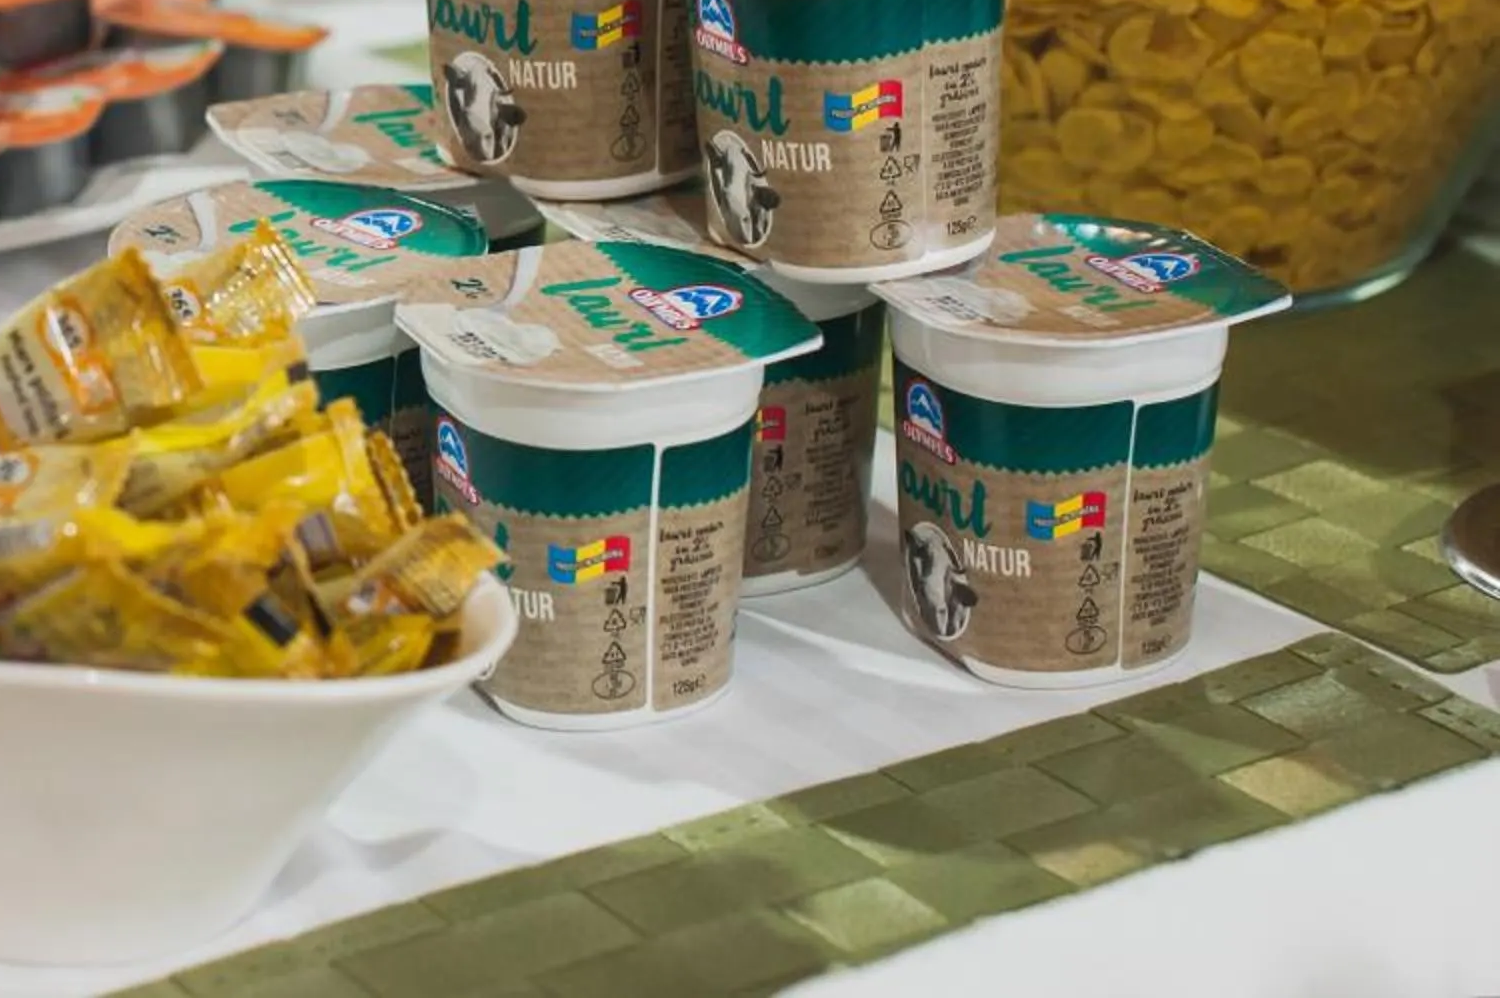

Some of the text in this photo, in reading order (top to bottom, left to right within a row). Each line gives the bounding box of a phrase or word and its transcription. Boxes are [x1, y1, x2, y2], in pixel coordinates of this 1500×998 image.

[509, 57, 577, 89] NATUR
[695, 68, 790, 136] aurt
[762, 139, 832, 172] NATUR
[541, 276, 690, 351] Iaurt
[902, 460, 992, 538] aurt
[963, 537, 1031, 577] NATUR
[510, 587, 555, 621] TUR
